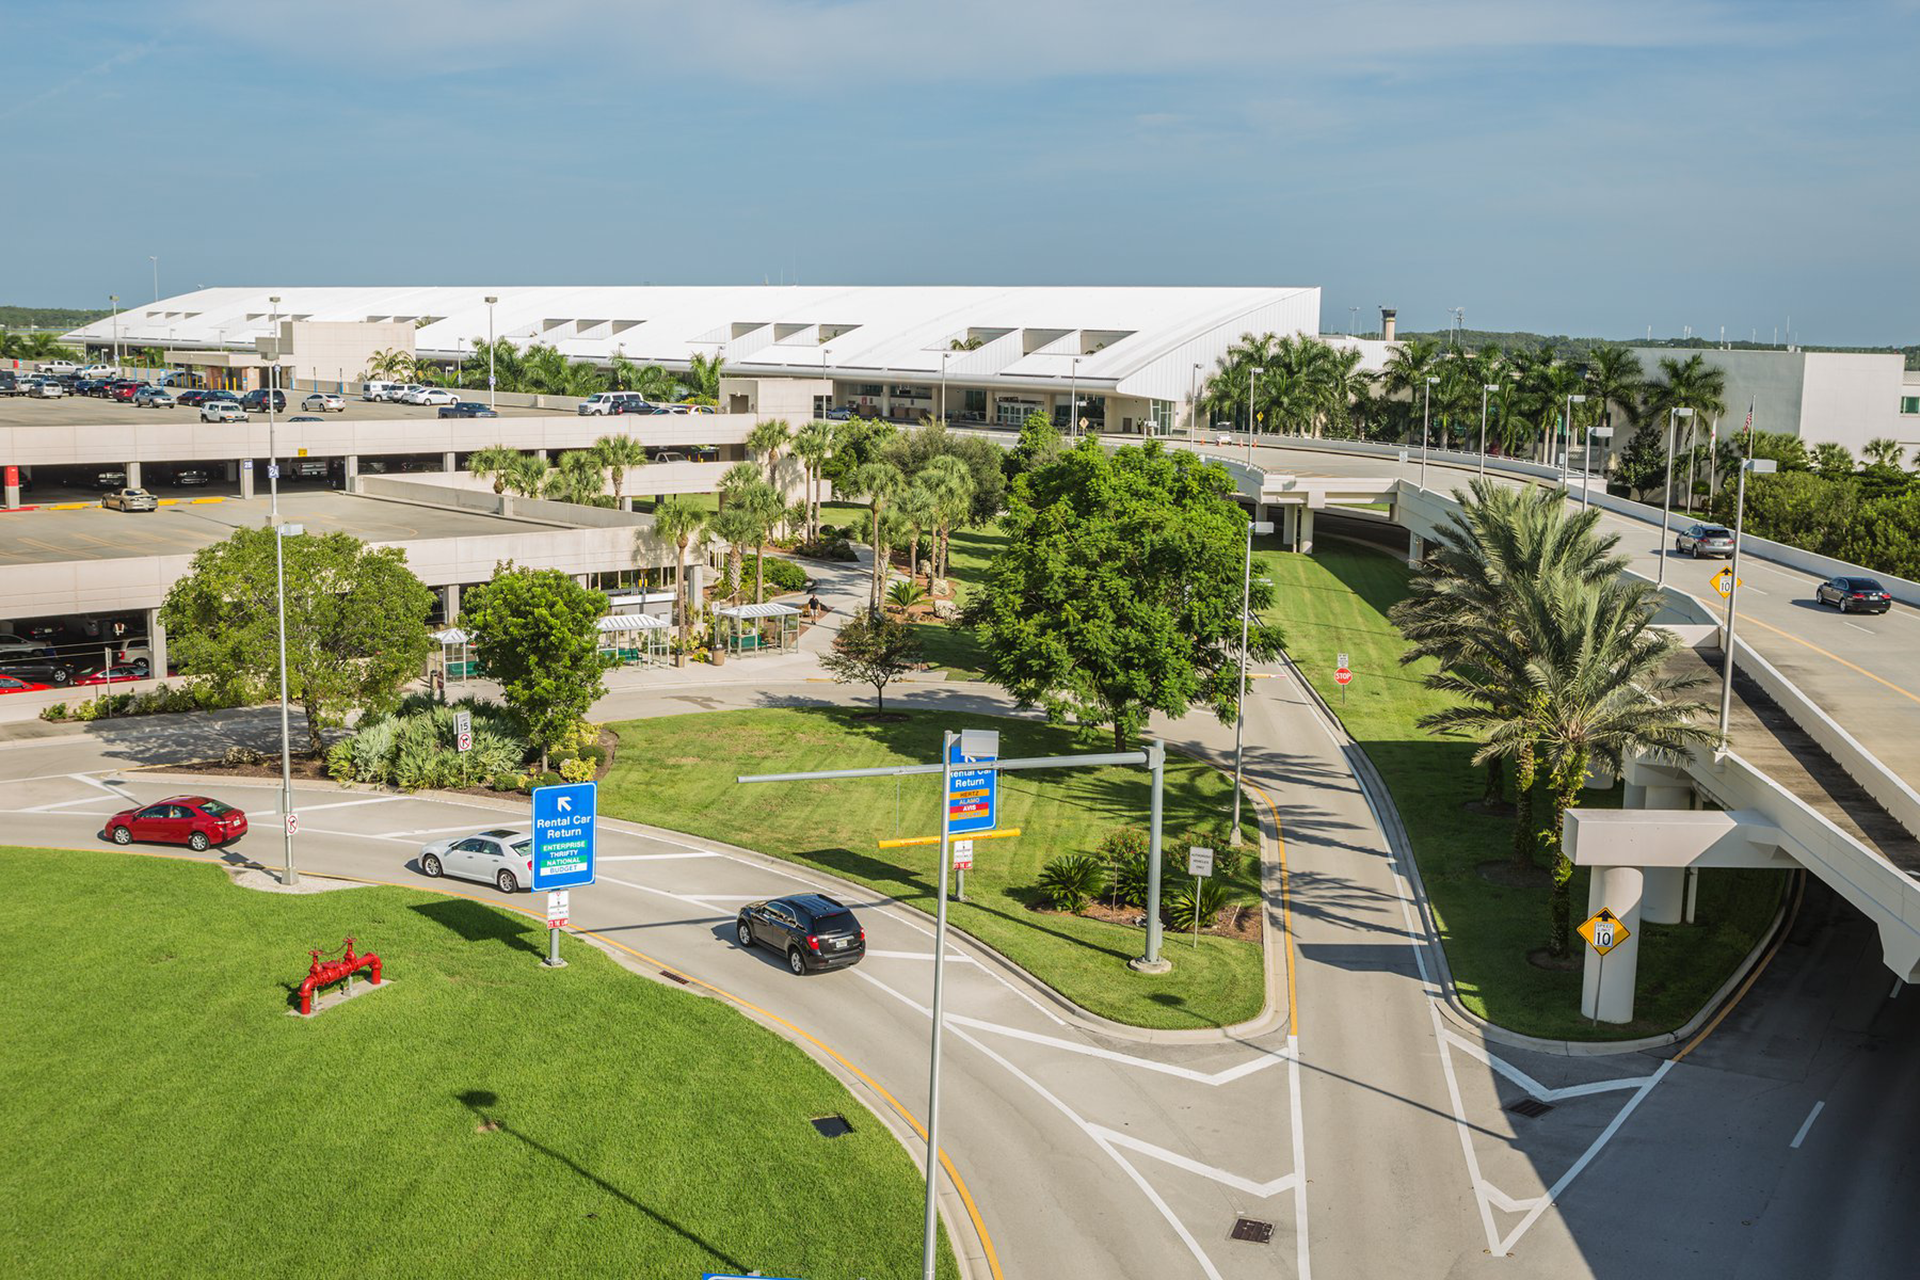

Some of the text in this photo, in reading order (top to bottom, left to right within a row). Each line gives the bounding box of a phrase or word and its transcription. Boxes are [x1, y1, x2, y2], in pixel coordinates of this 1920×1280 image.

[269, 467, 279, 477] 2A
[1721, 582, 1730, 591] 10
[1336, 672, 1351, 680] STOP
[460, 722, 469, 731] 15
[955, 778, 985, 788] Return
[537, 815, 591, 828] Rental Car
[547, 828, 581, 839] Return
[543, 840, 585, 852] ENTERPRISE
[550, 849, 578, 859] THRIFTY
[547, 857, 580, 866] NATIONAL
[550, 864, 577, 874] BUDGET
[1597, 931, 1611, 945] 10
